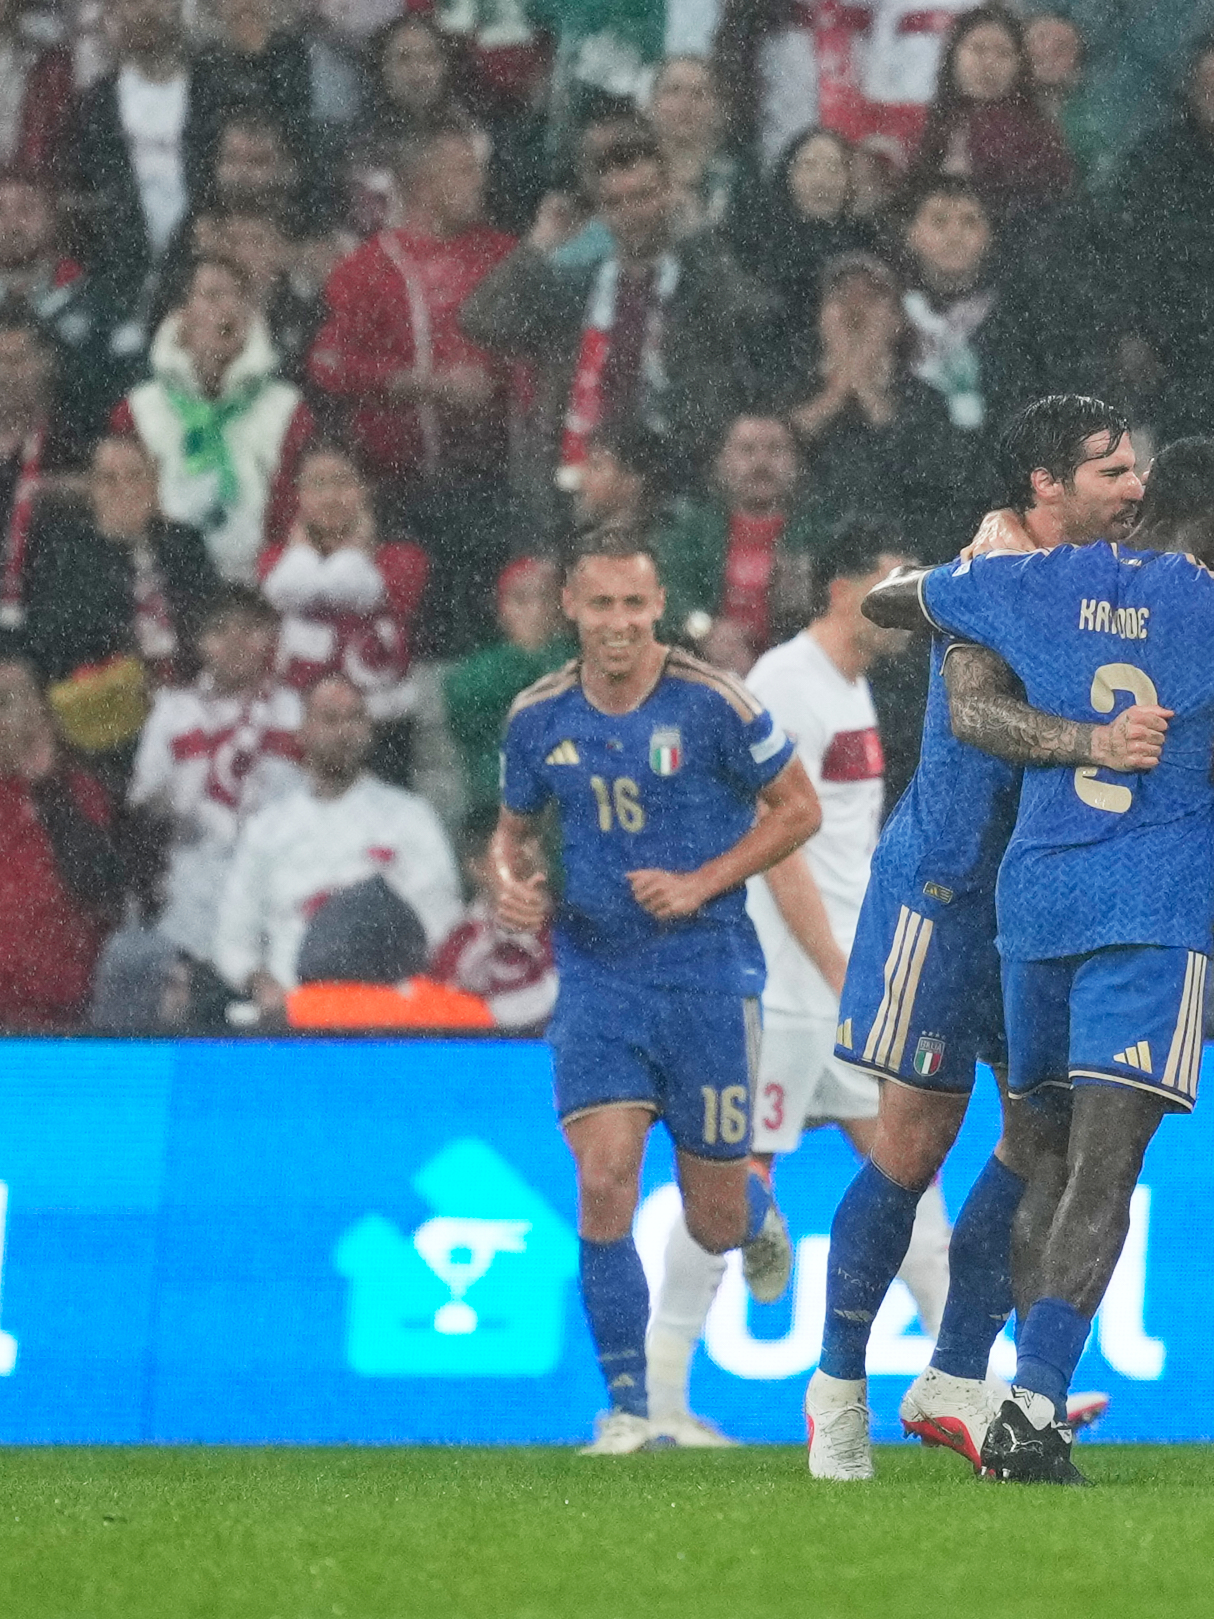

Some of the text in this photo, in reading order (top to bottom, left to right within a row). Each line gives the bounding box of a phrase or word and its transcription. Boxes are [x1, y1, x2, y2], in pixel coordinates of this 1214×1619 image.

[1074, 662, 1158, 814] 2
[590, 775, 645, 833] 16
[702, 1084, 747, 1145] 16
[764, 1083, 784, 1130] 3
